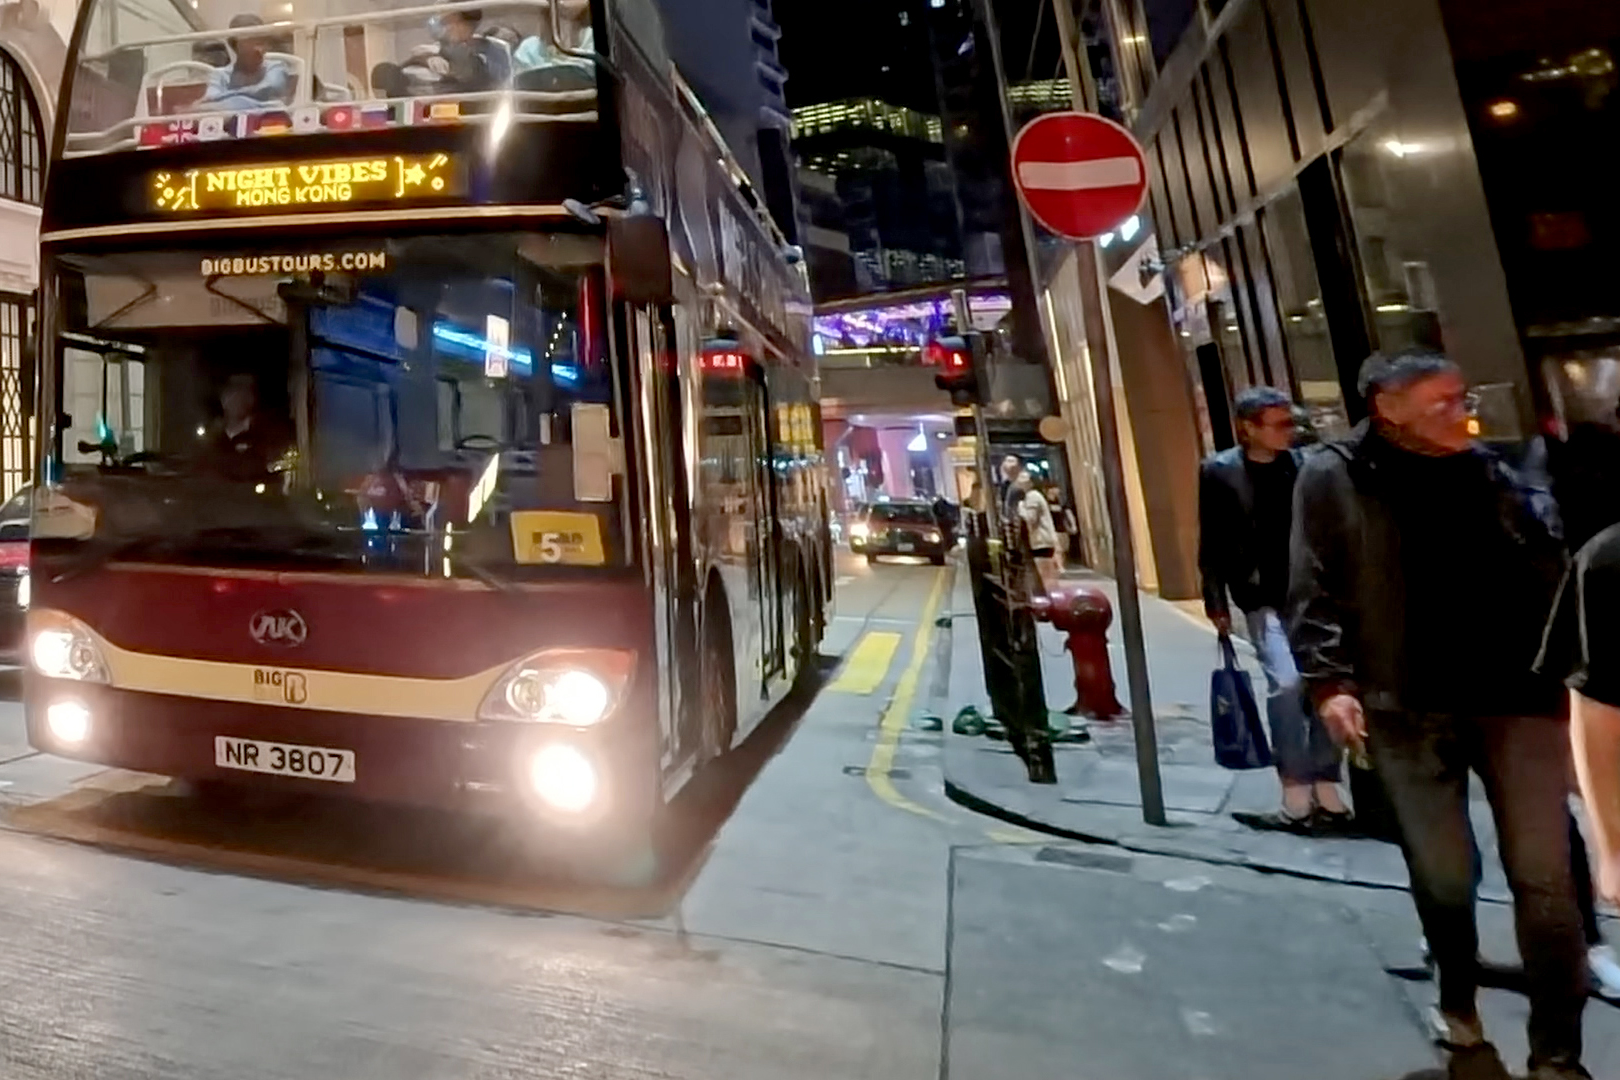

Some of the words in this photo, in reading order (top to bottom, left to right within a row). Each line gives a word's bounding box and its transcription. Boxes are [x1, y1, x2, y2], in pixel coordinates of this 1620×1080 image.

[206, 167, 291, 192] NIGHT
[298, 160, 388, 185] VIBES
[236, 186, 291, 206] HONG
[295, 183, 352, 203] KONG
[201, 252, 386, 276] BIGBUSTOURS.COM
[254, 669, 282, 686] BIG
[225, 741, 259, 767] NR
[270, 747, 344, 778] 3807
